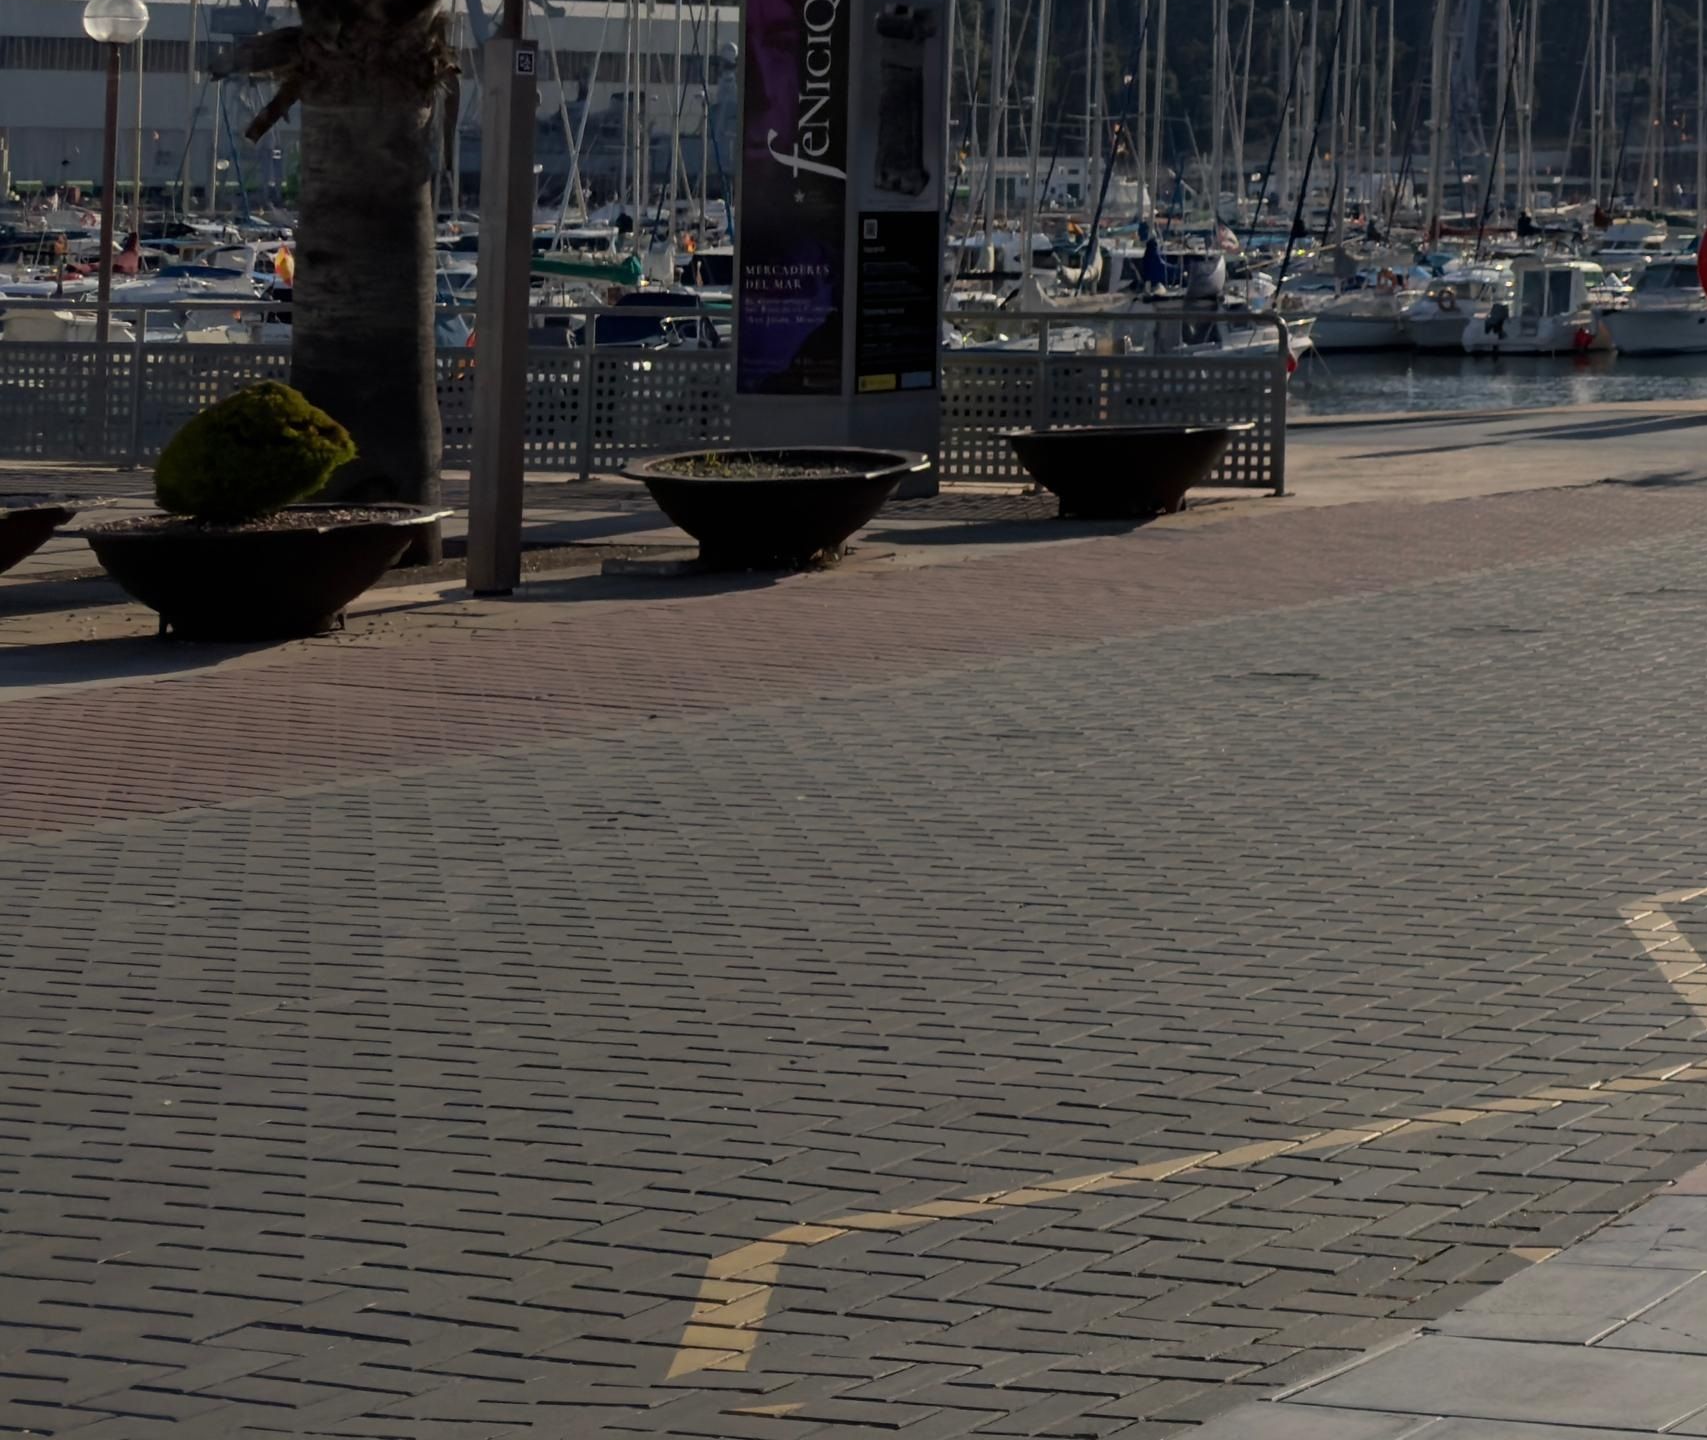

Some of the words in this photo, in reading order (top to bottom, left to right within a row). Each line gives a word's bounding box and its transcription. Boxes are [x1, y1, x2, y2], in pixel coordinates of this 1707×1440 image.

[745, 264, 832, 276] MERCADERES
[745, 279, 769, 290] DEL
[775, 279, 803, 289] MAR
